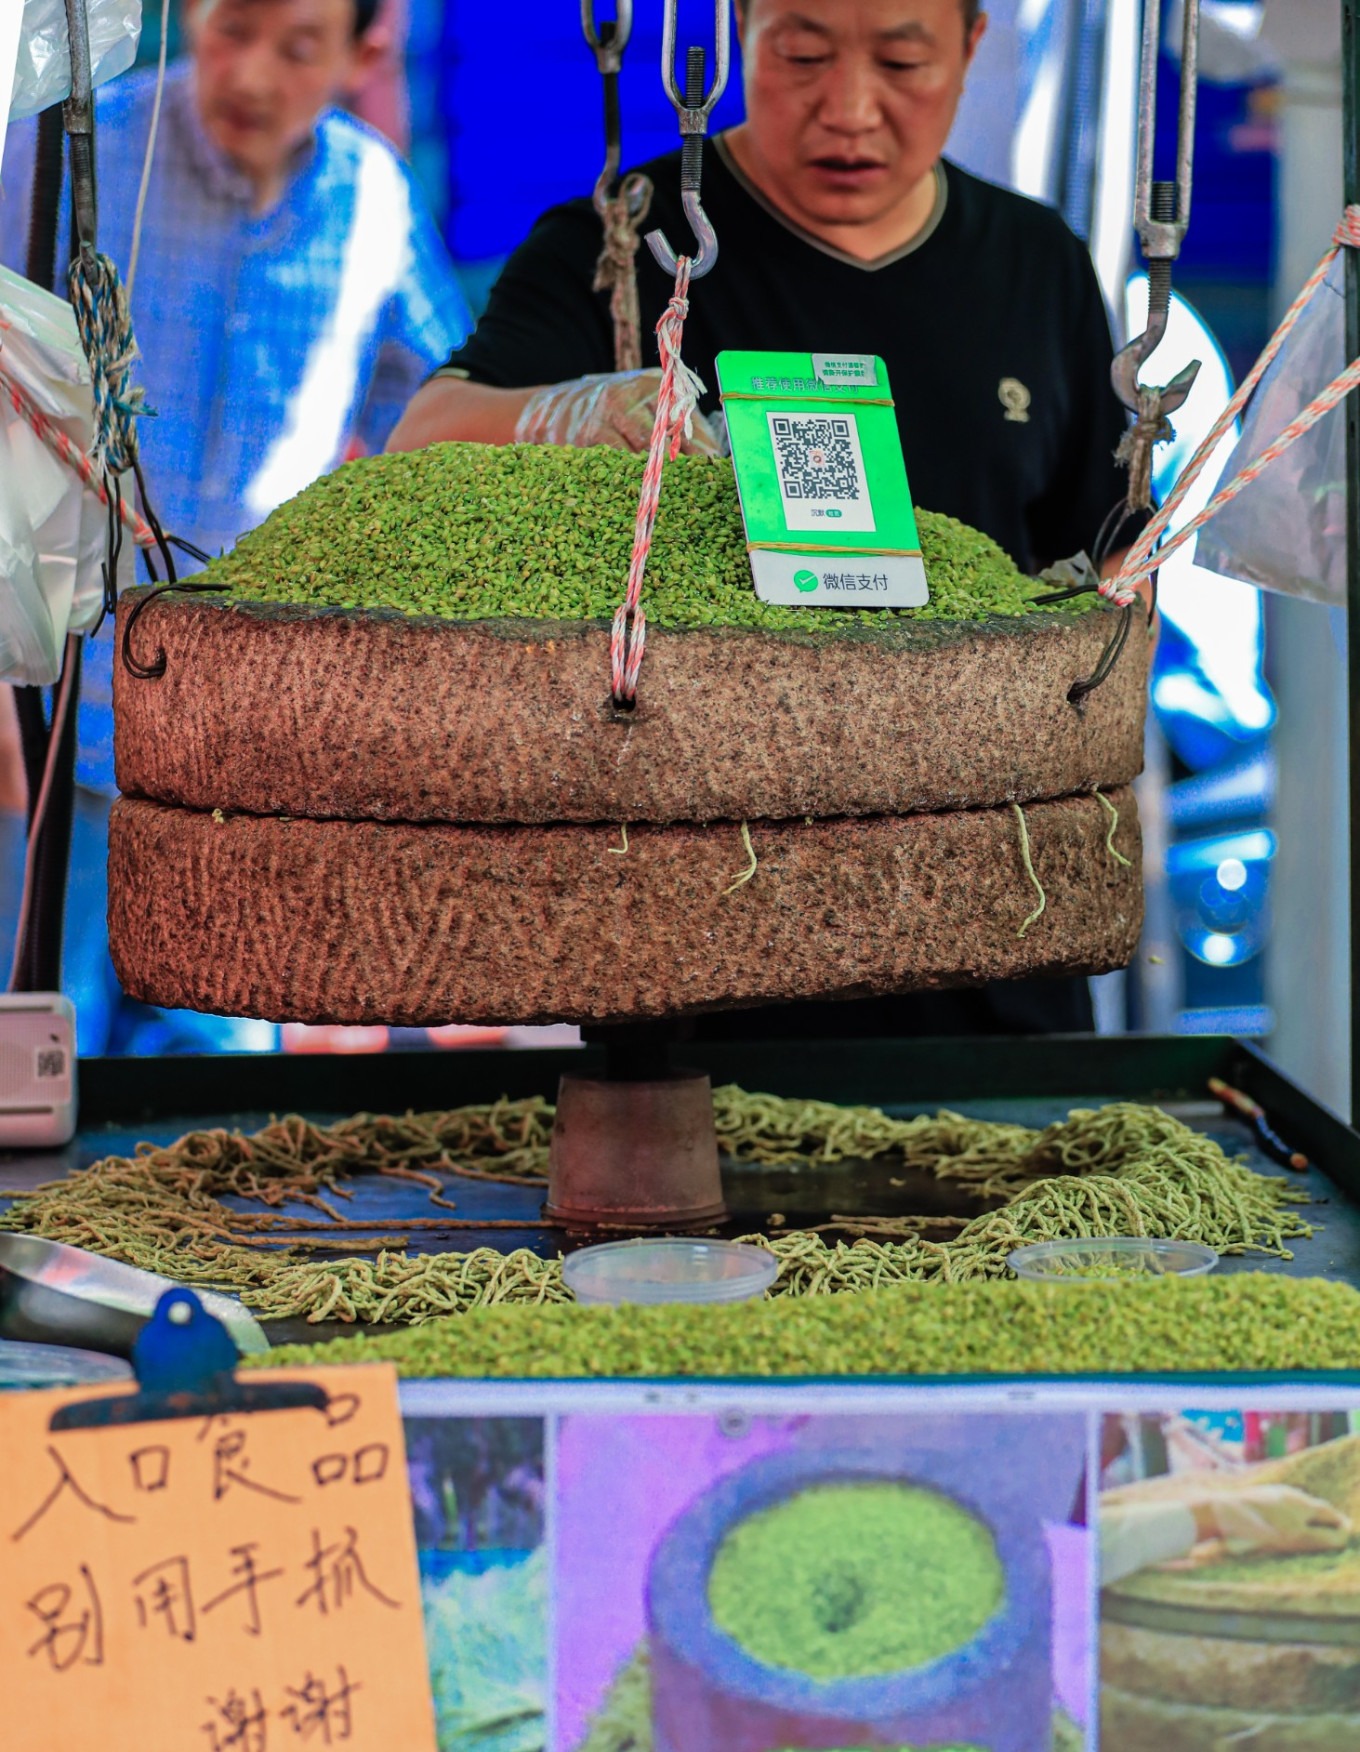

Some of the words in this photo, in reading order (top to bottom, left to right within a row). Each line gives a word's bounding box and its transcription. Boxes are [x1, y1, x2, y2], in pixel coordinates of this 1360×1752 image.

[822, 573, 889, 591] 微信支付
[12, 1394, 390, 1543] 入口食品
[26, 1526, 402, 1672] 别用手抓
[200, 1665, 362, 1752] 谢谢
